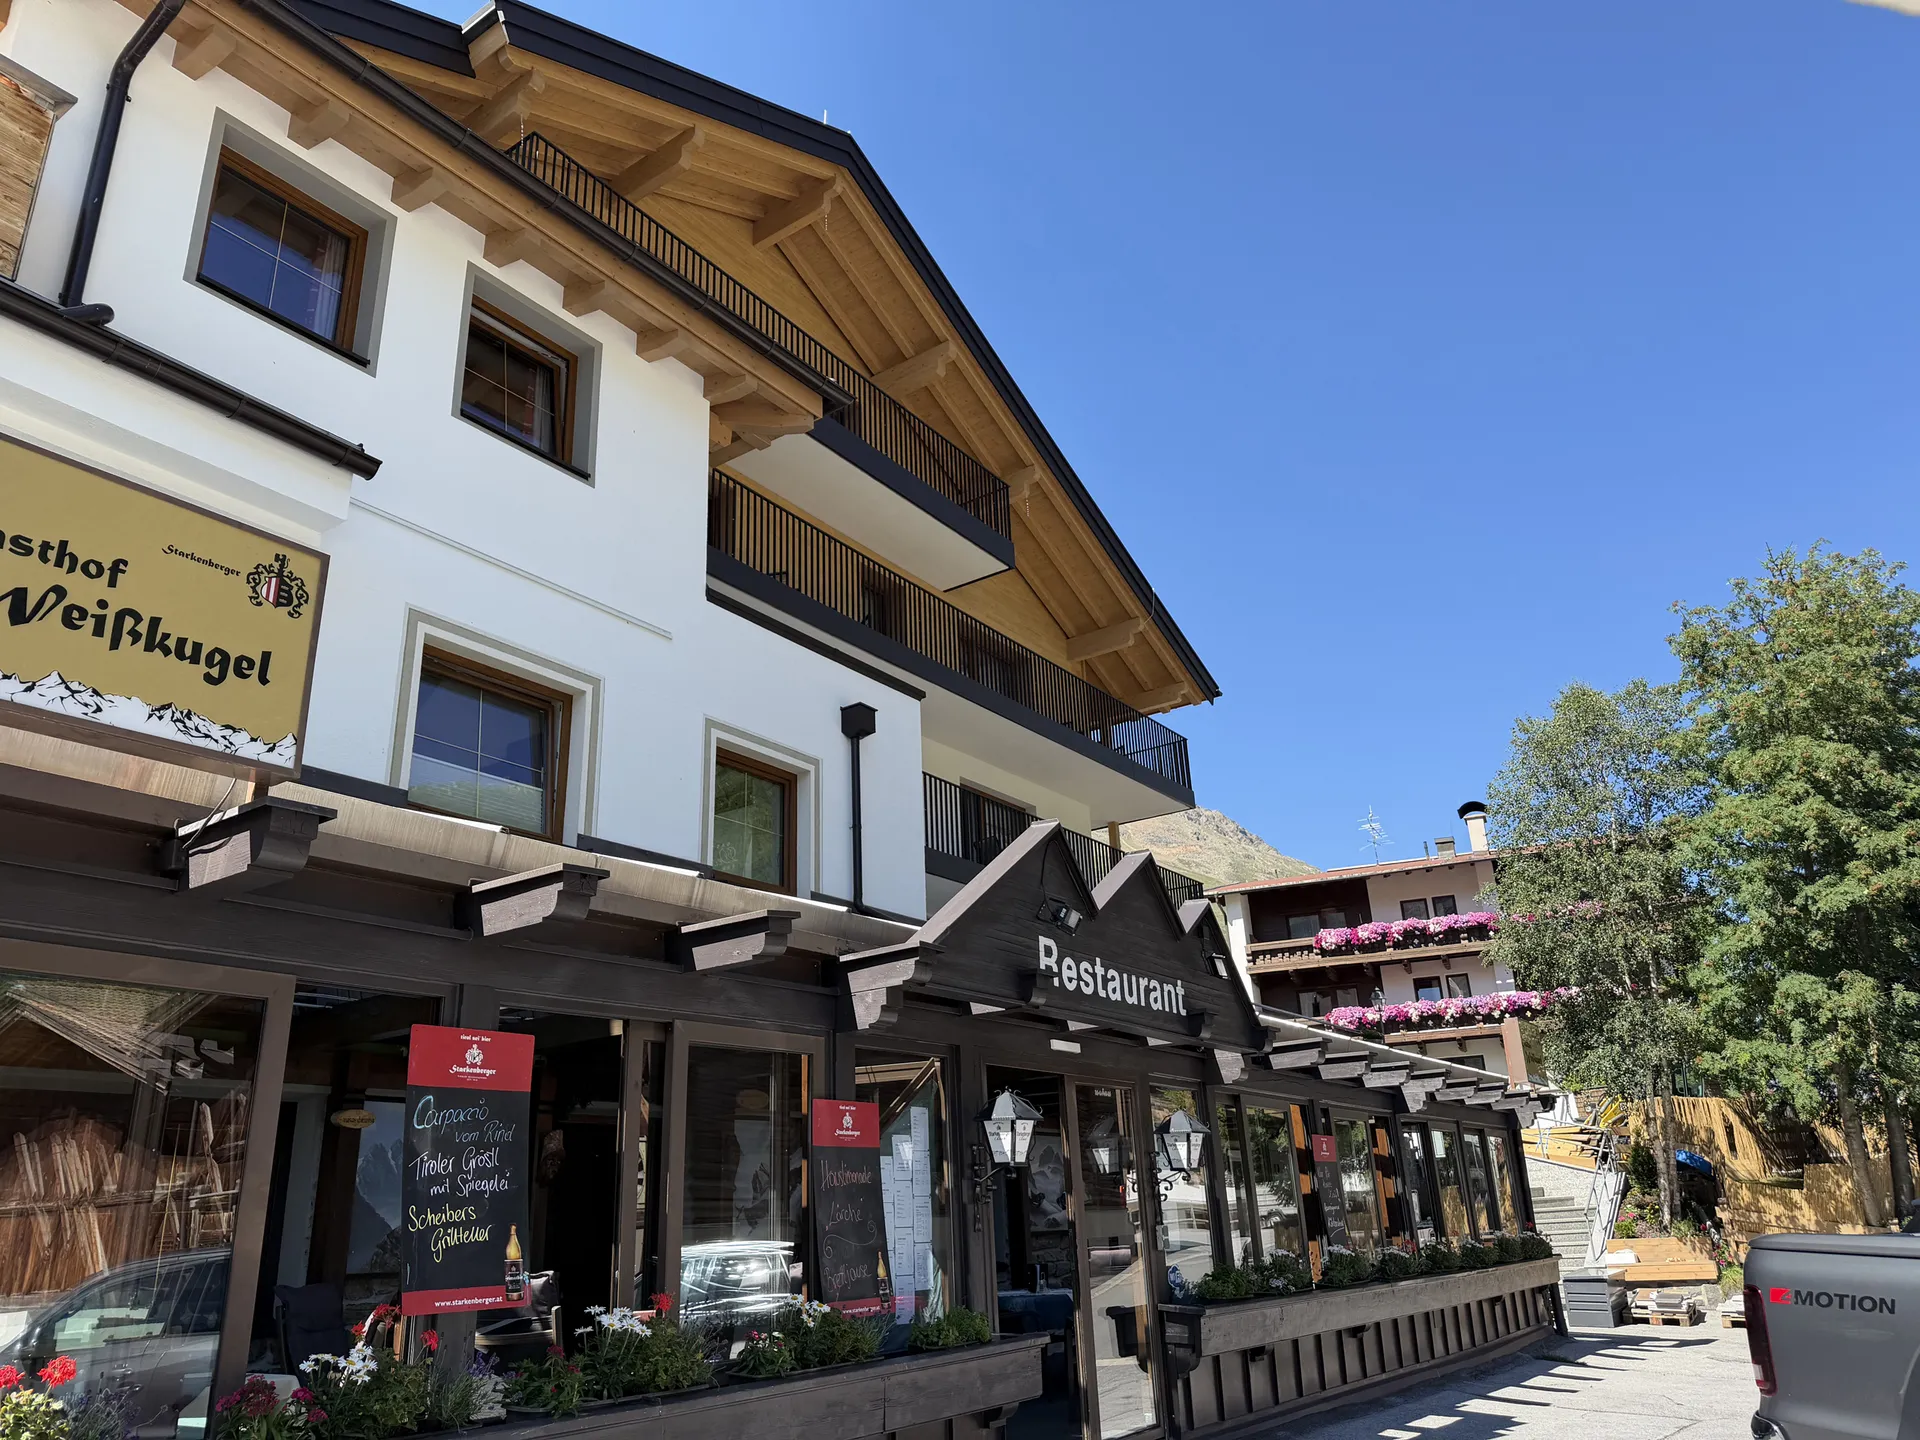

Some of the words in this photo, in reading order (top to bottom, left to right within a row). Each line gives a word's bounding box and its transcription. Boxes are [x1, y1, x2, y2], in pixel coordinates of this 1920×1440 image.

[161, 544, 241, 577] Starkenberger
[1038, 935, 1187, 1016] Restaurant
[448, 1064, 497, 1077] Starkenberger
[455, 1131, 480, 1143] vom
[483, 1119, 516, 1143] Rind
[408, 1151, 456, 1181] Tiroler
[462, 1146, 500, 1180] Gröstl
[430, 1178, 450, 1197] mit
[456, 1172, 511, 1198] Spiegelei
[408, 1203, 477, 1232] Scheibers
[431, 1223, 493, 1263] Grillteller
[434, 1296, 503, 1308] www.starkenberger.at
